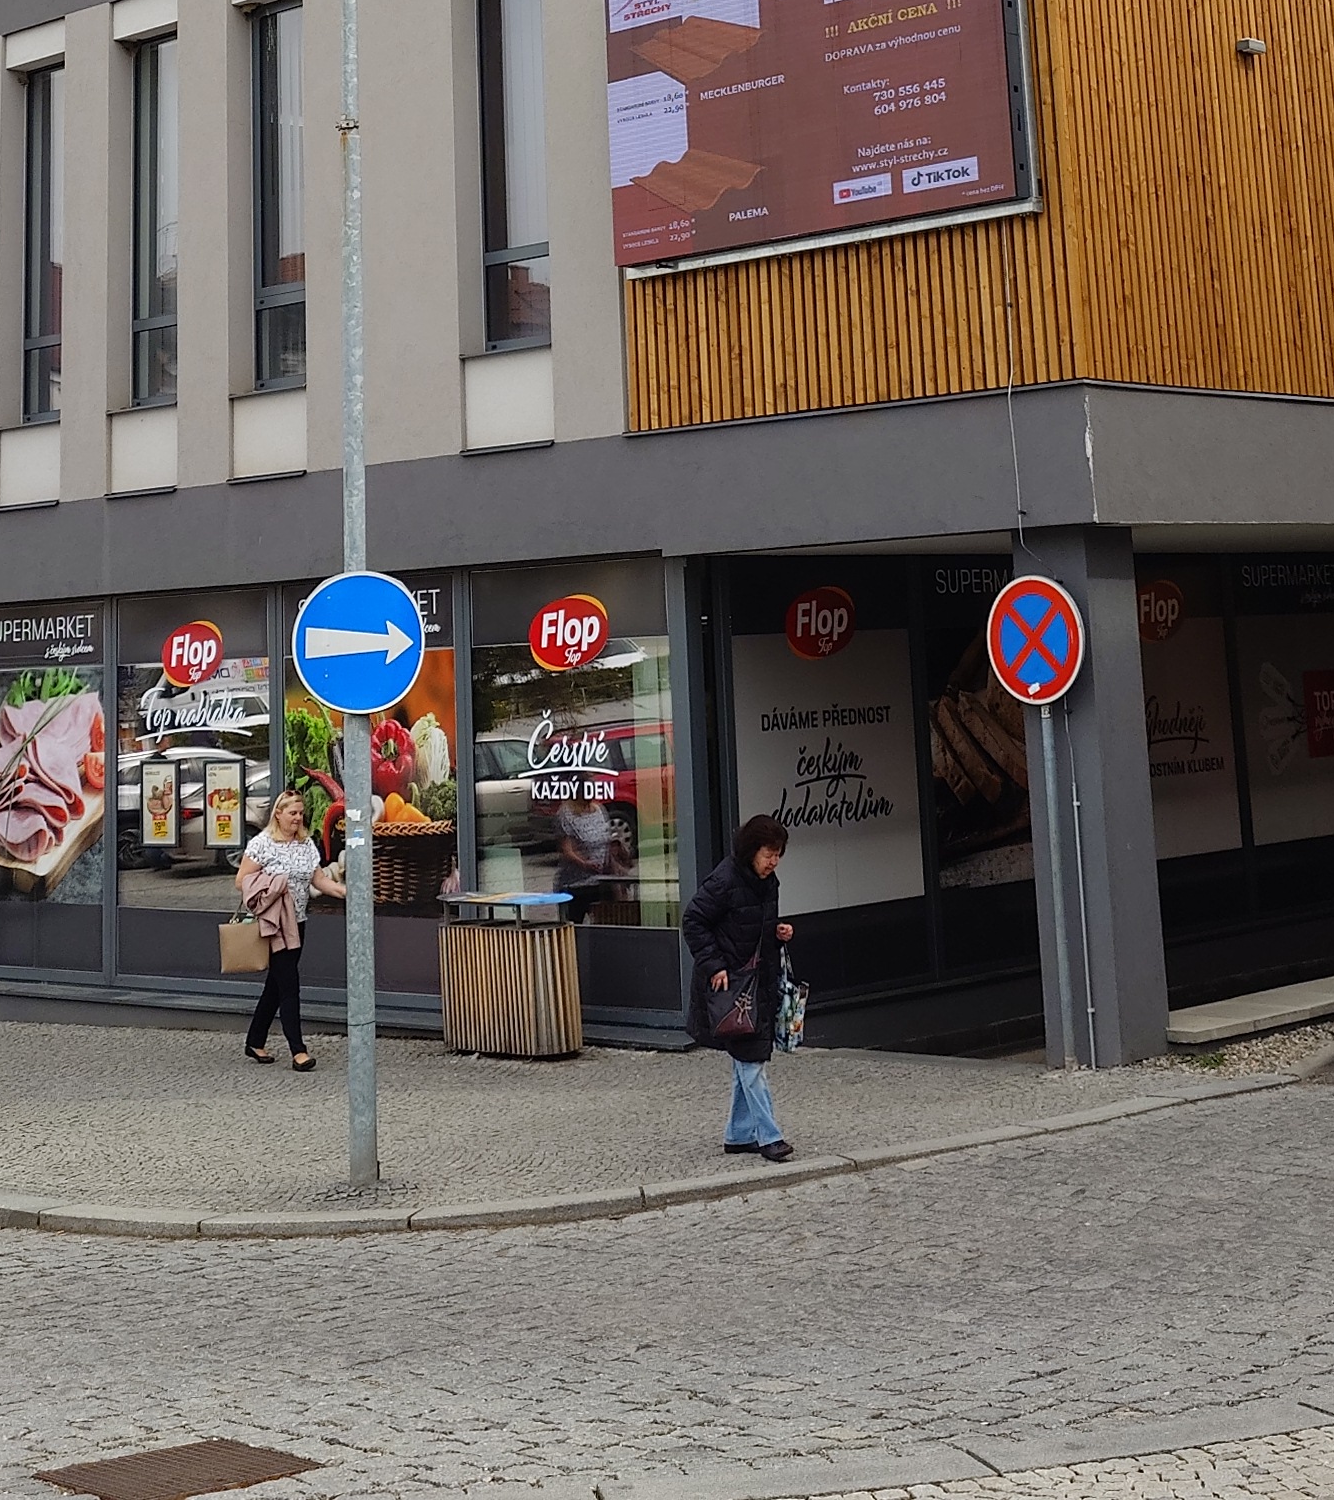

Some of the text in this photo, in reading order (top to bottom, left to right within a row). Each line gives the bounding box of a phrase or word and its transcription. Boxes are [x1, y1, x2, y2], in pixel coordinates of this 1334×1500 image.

[847, 9, 894, 34] AKČNÍ
[897, 2, 938, 21] CENA
[825, 24, 961, 62] DOPRAVA za výhodnou cenu
[700, 74, 785, 100] MECKLENBURGER
[843, 78, 890, 95] Kontakty:
[873, 78, 946, 102] 730 556 445
[874, 92, 947, 115] 604 976 804
[857, 136, 932, 159] Najdete nás na:
[852, 148, 948, 173] www.styl-strechy.cz
[926, 166, 970, 184] TikTok
[850, 185, 877, 196] YouTube
[729, 207, 769, 222] PALEMA
[935, 568, 1009, 594] SUPERM
[796, 600, 848, 640] Flop
[1139, 592, 1180, 627] Flop
[541, 610, 600, 651] Flop
[171, 633, 216, 670] Flop
[564, 646, 581, 665] Top
[818, 637, 833, 655] Top
[188, 666, 202, 682] Top
[140, 687, 246, 744] Top nabídka
[761, 704, 891, 732] DÁVÁME PŘEDNOST
[528, 709, 609, 769] Čerstvé
[796, 737, 864, 798] českým
[1187, 756, 1225, 775] KLUBEM
[531, 775, 614, 800] KAŽDÝ DEN
[771, 781, 893, 828] dodavatelům
